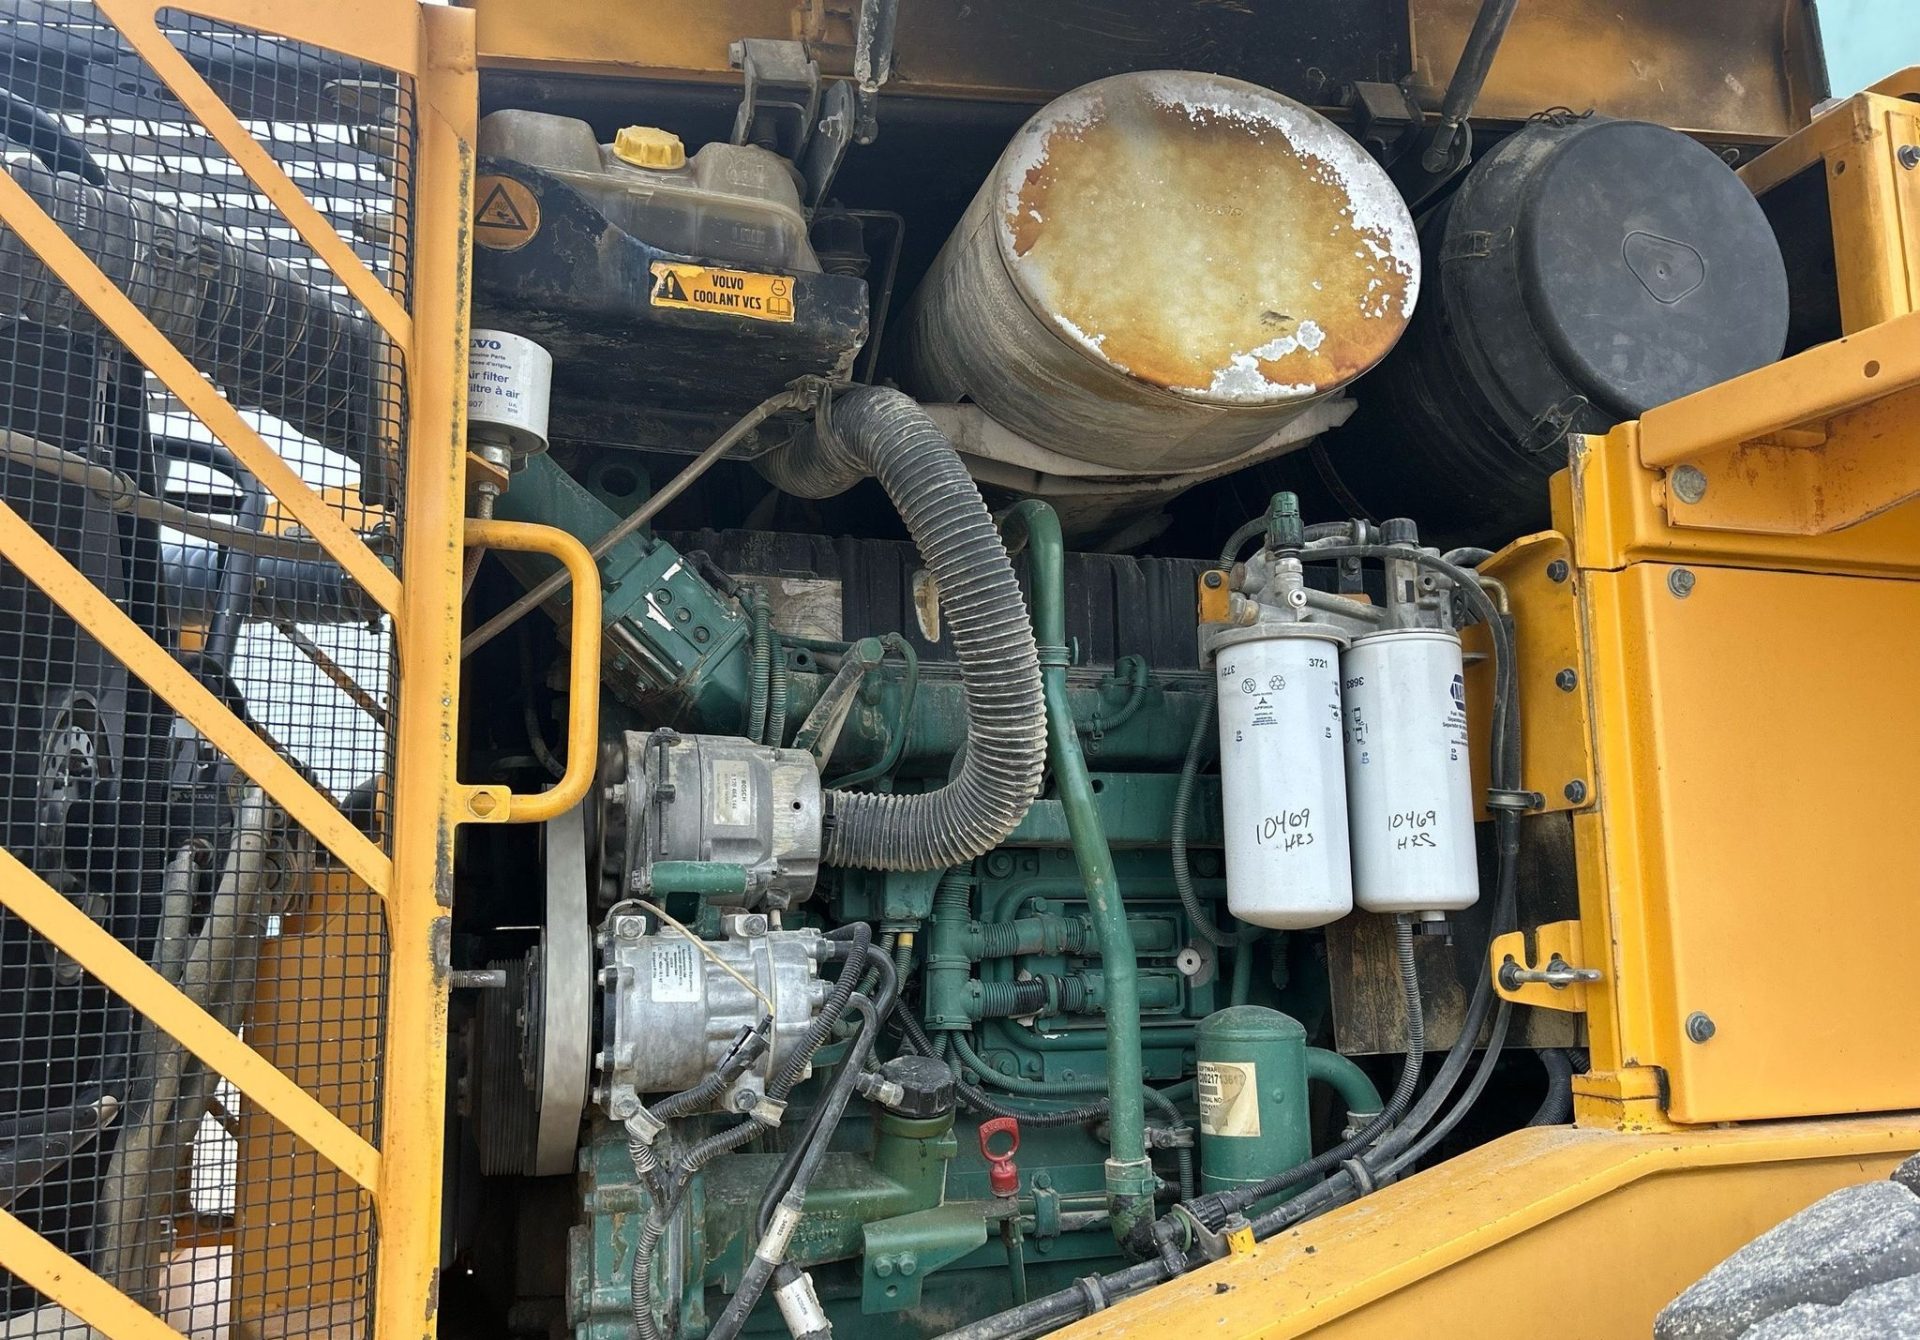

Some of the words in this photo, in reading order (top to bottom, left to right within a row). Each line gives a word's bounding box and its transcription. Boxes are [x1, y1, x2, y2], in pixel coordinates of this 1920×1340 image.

[712, 274, 743, 290] VOLVO
[693, 289, 740, 307] COOLANT
[743, 296, 762, 310] VCS
[469, 338, 502, 350] LVO
[483, 371, 510, 384] filter
[468, 383, 492, 394] iltre
[495, 385, 503, 395] à
[505, 389, 521, 399] air
[1308, 658, 1328, 669] 3721
[1346, 676, 1364, 690] 3683
[1256, 807, 1311, 845] 10469
[1387, 810, 1437, 832] 10469
[1284, 832, 1314, 852] HRS
[1397, 832, 1437, 850] HRS
